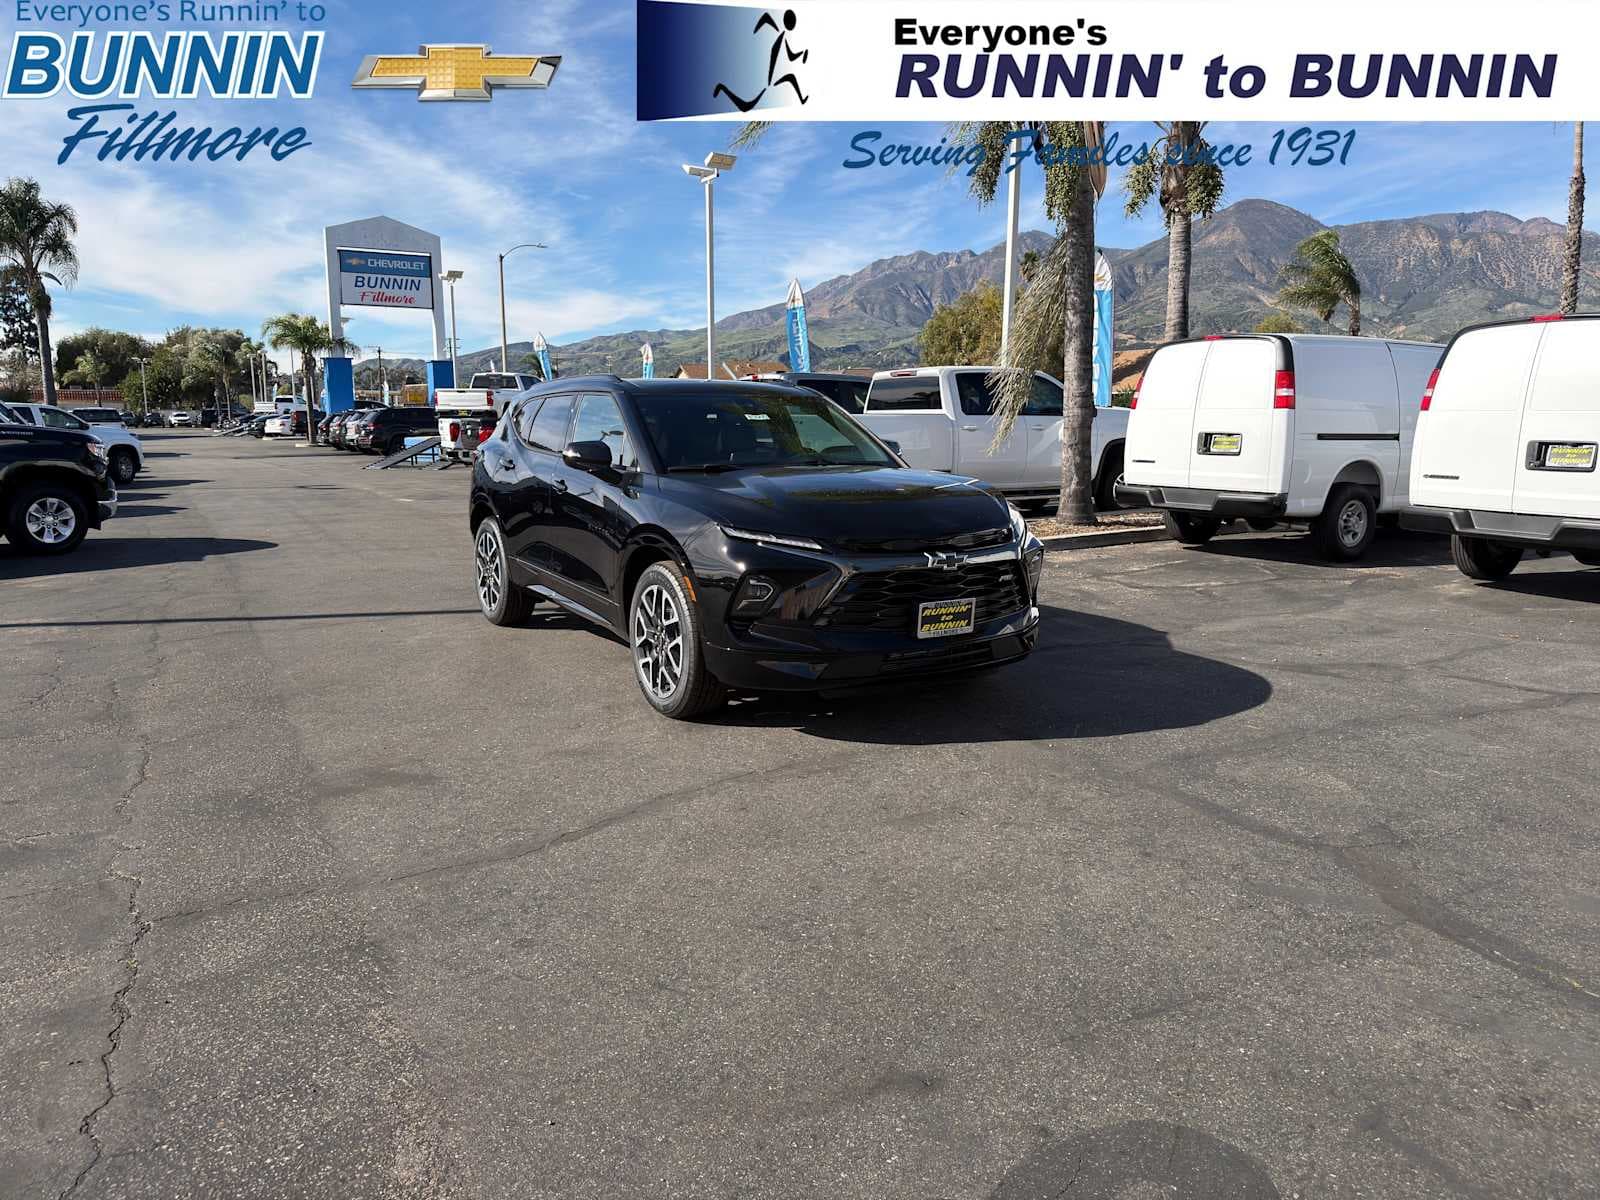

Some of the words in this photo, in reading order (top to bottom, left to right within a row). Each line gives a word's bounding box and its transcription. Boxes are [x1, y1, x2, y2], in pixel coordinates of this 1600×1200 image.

[367, 259, 425, 270] CHEVROLET
[354, 275, 421, 291] BUNNIN
[360, 291, 416, 304] Fillmore
[922, 604, 972, 617] RUNNIN'
[921, 620, 968, 632] BUNNIN
